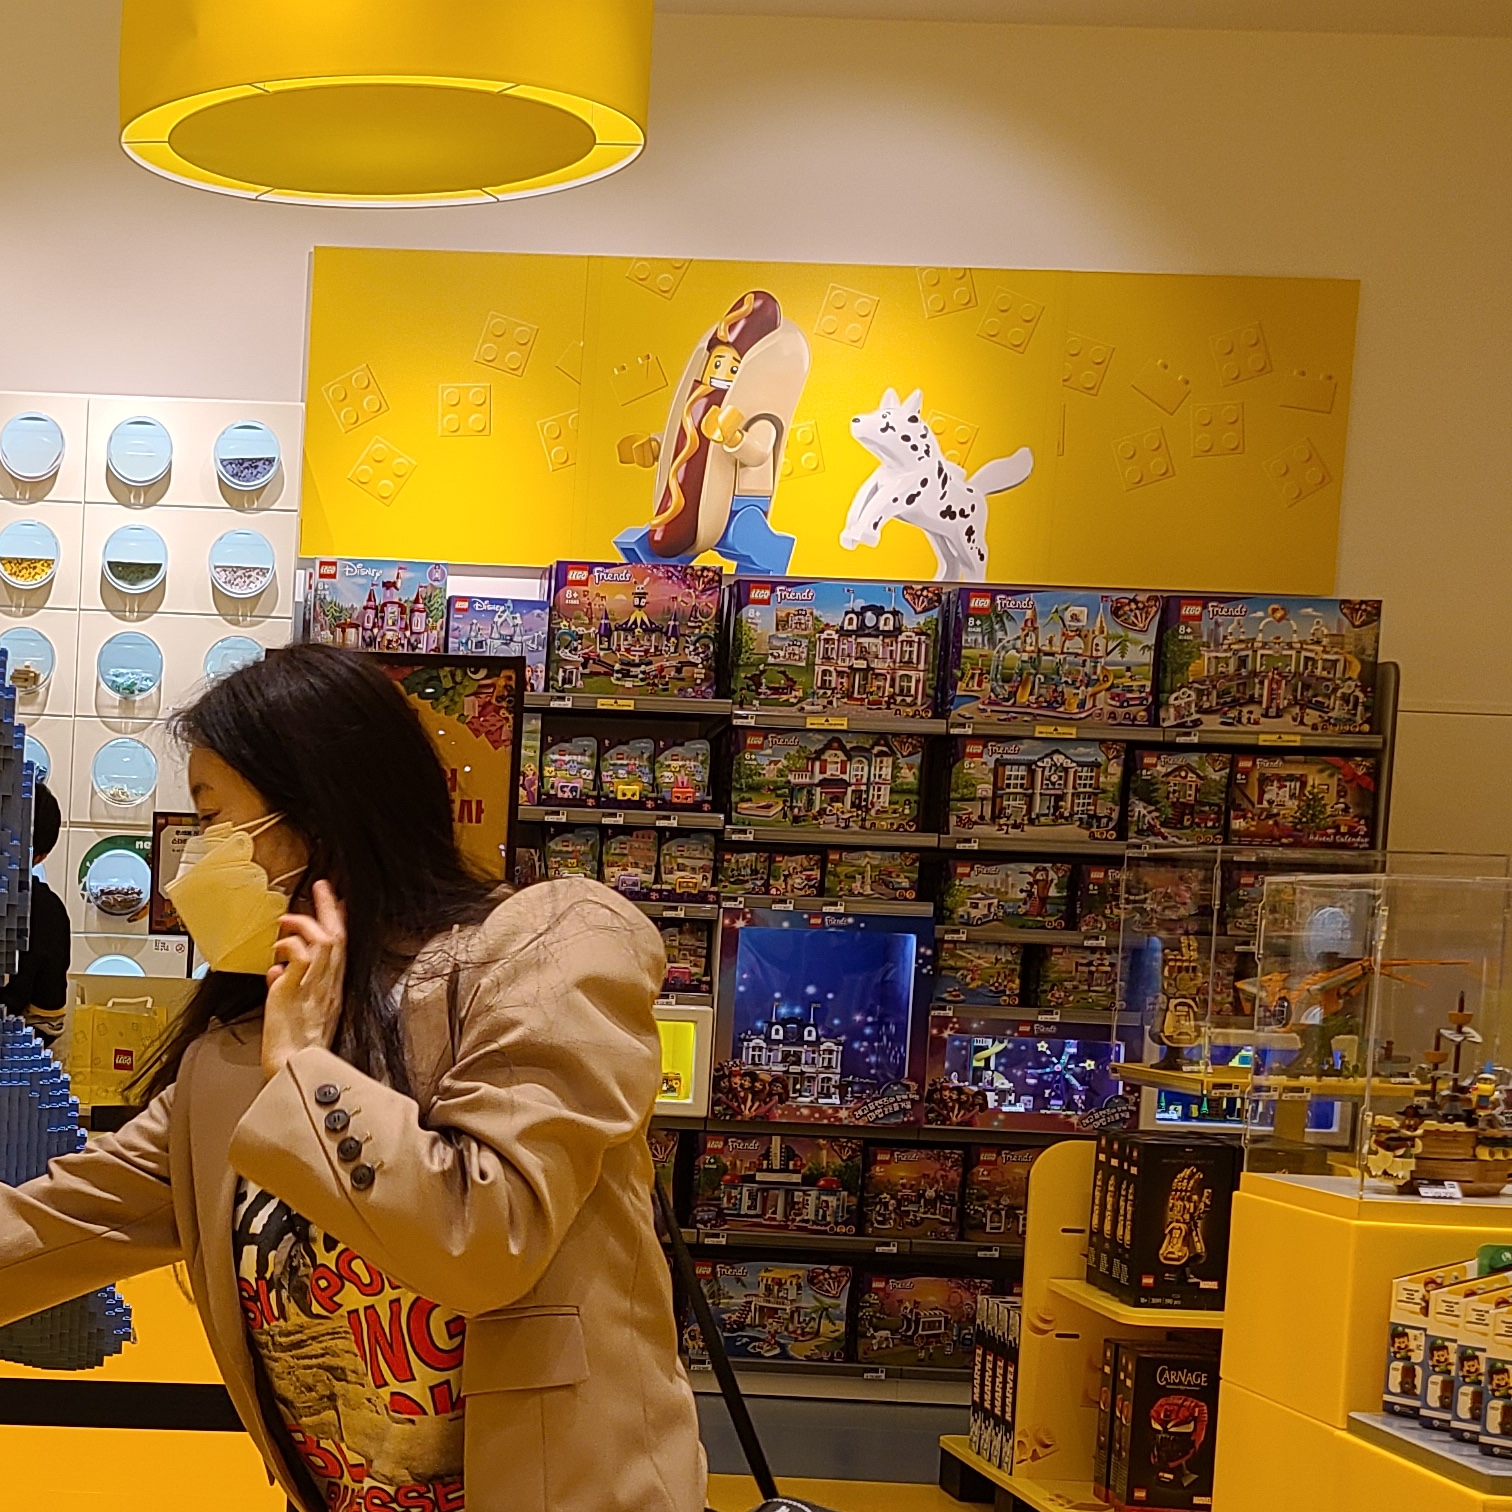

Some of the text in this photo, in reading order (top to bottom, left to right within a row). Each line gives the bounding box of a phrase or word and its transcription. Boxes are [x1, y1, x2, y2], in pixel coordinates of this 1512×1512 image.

[342, 562, 383, 581] Disney
[593, 568, 632, 585] Friends
[776, 586, 815, 602] Friends
[996, 595, 1034, 612] Friends
[1207, 602, 1247, 619] Friends
[768, 732, 800, 748] Friends
[988, 740, 1020, 756] Friends
[135, 840, 152, 849] ne
[728, 1137, 760, 1152] Friends
[1000, 1149, 1034, 1164] Friends
[715, 1263, 749, 1278] Friends
[973, 1345, 983, 1403] MARVEL
[983, 1351, 994, 1410] MARVEL
[994, 1356, 1005, 1417] MARVEL
[1005, 1361, 1015, 1423] MARVEL
